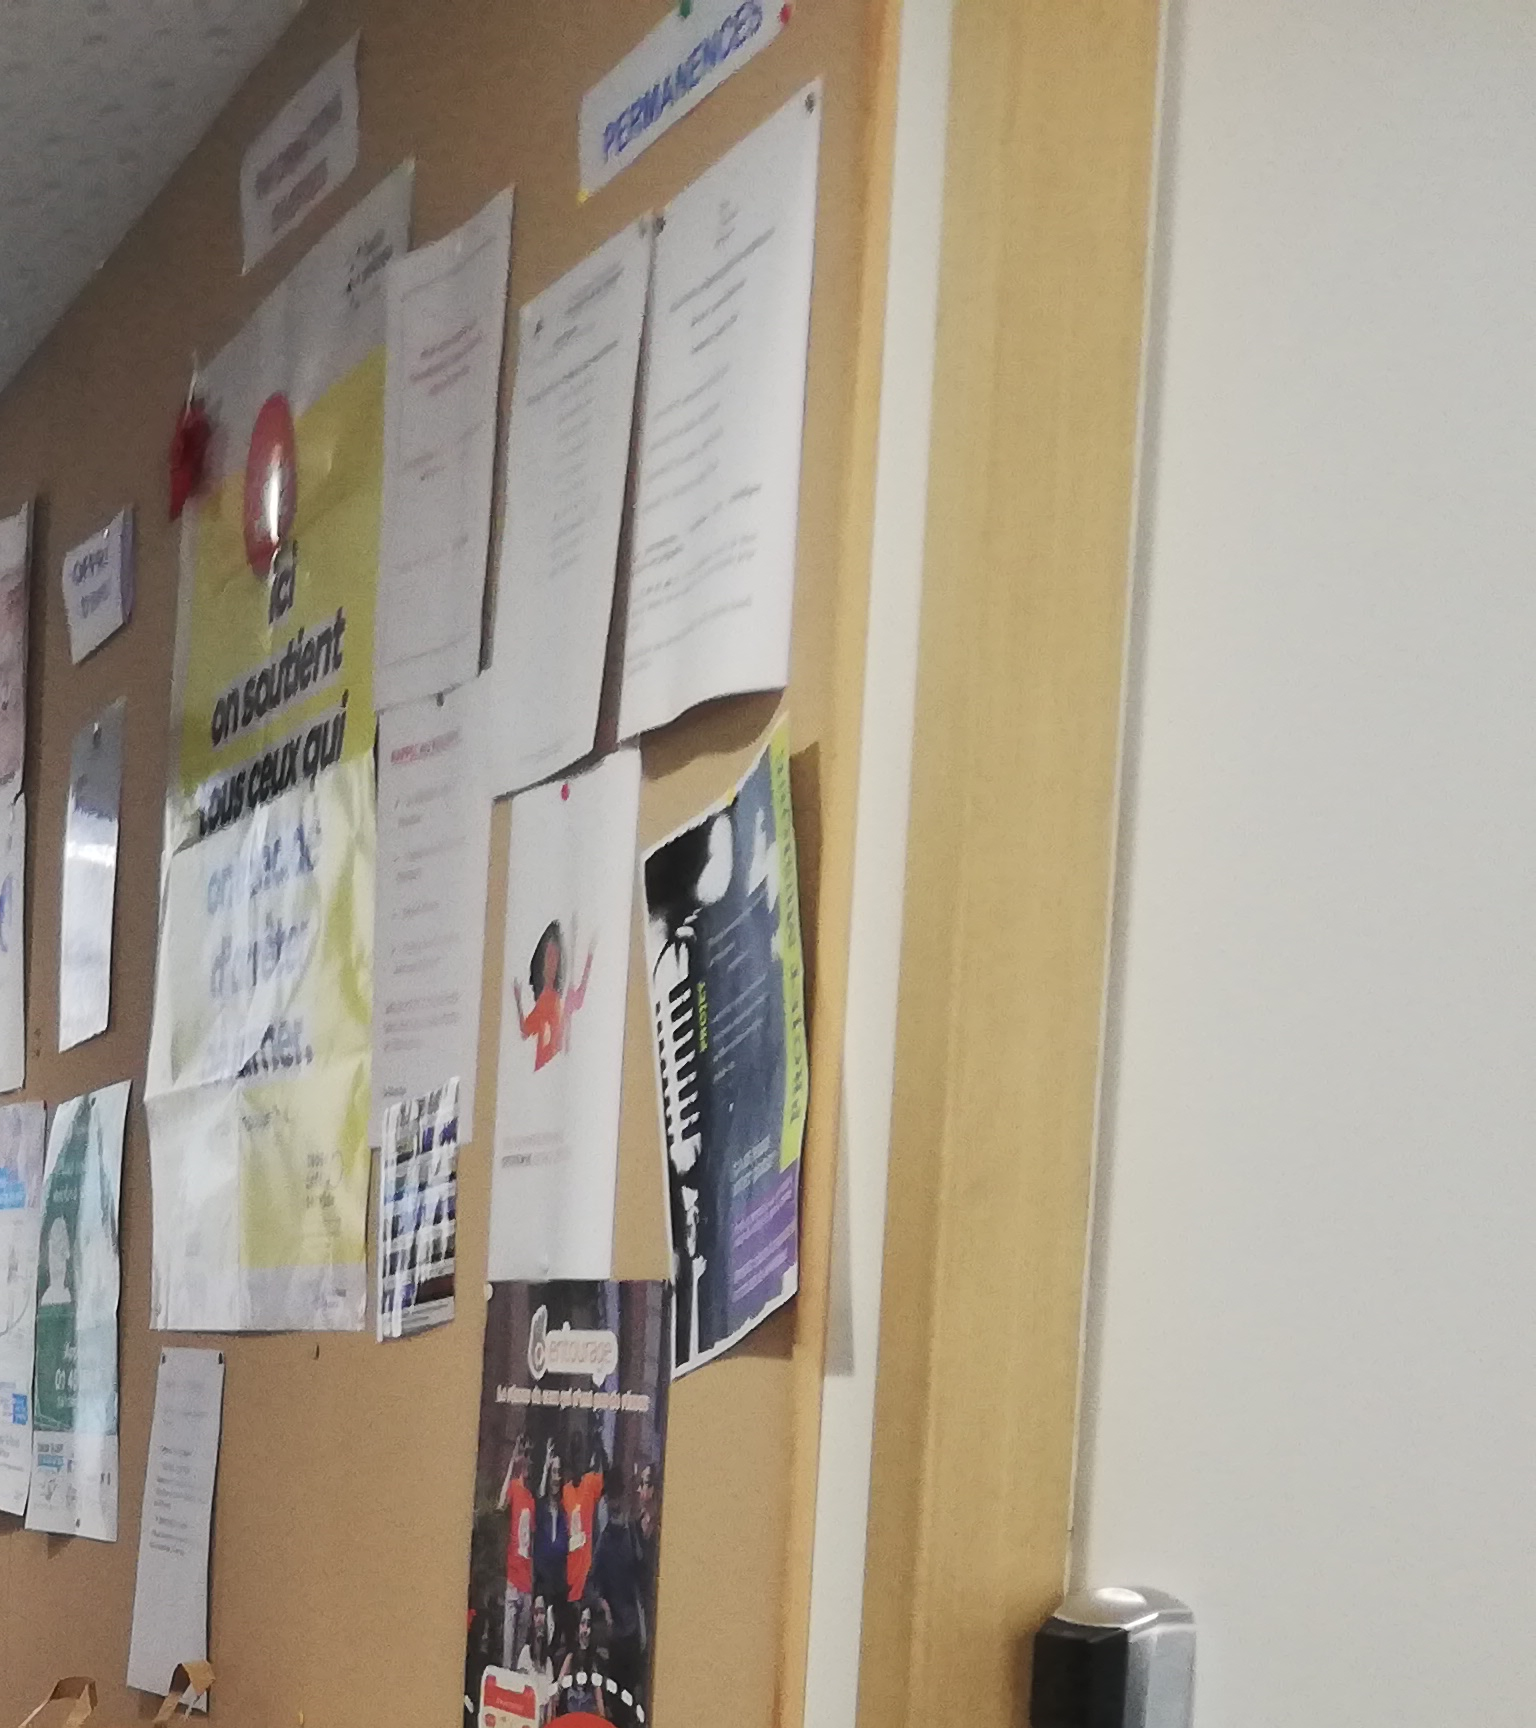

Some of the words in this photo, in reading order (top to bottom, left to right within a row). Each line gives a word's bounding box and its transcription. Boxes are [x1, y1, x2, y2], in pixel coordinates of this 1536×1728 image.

[212, 687, 240, 747] on
[241, 606, 346, 727] soutient
[247, 735, 302, 810] ceux
[303, 688, 349, 792] qui
